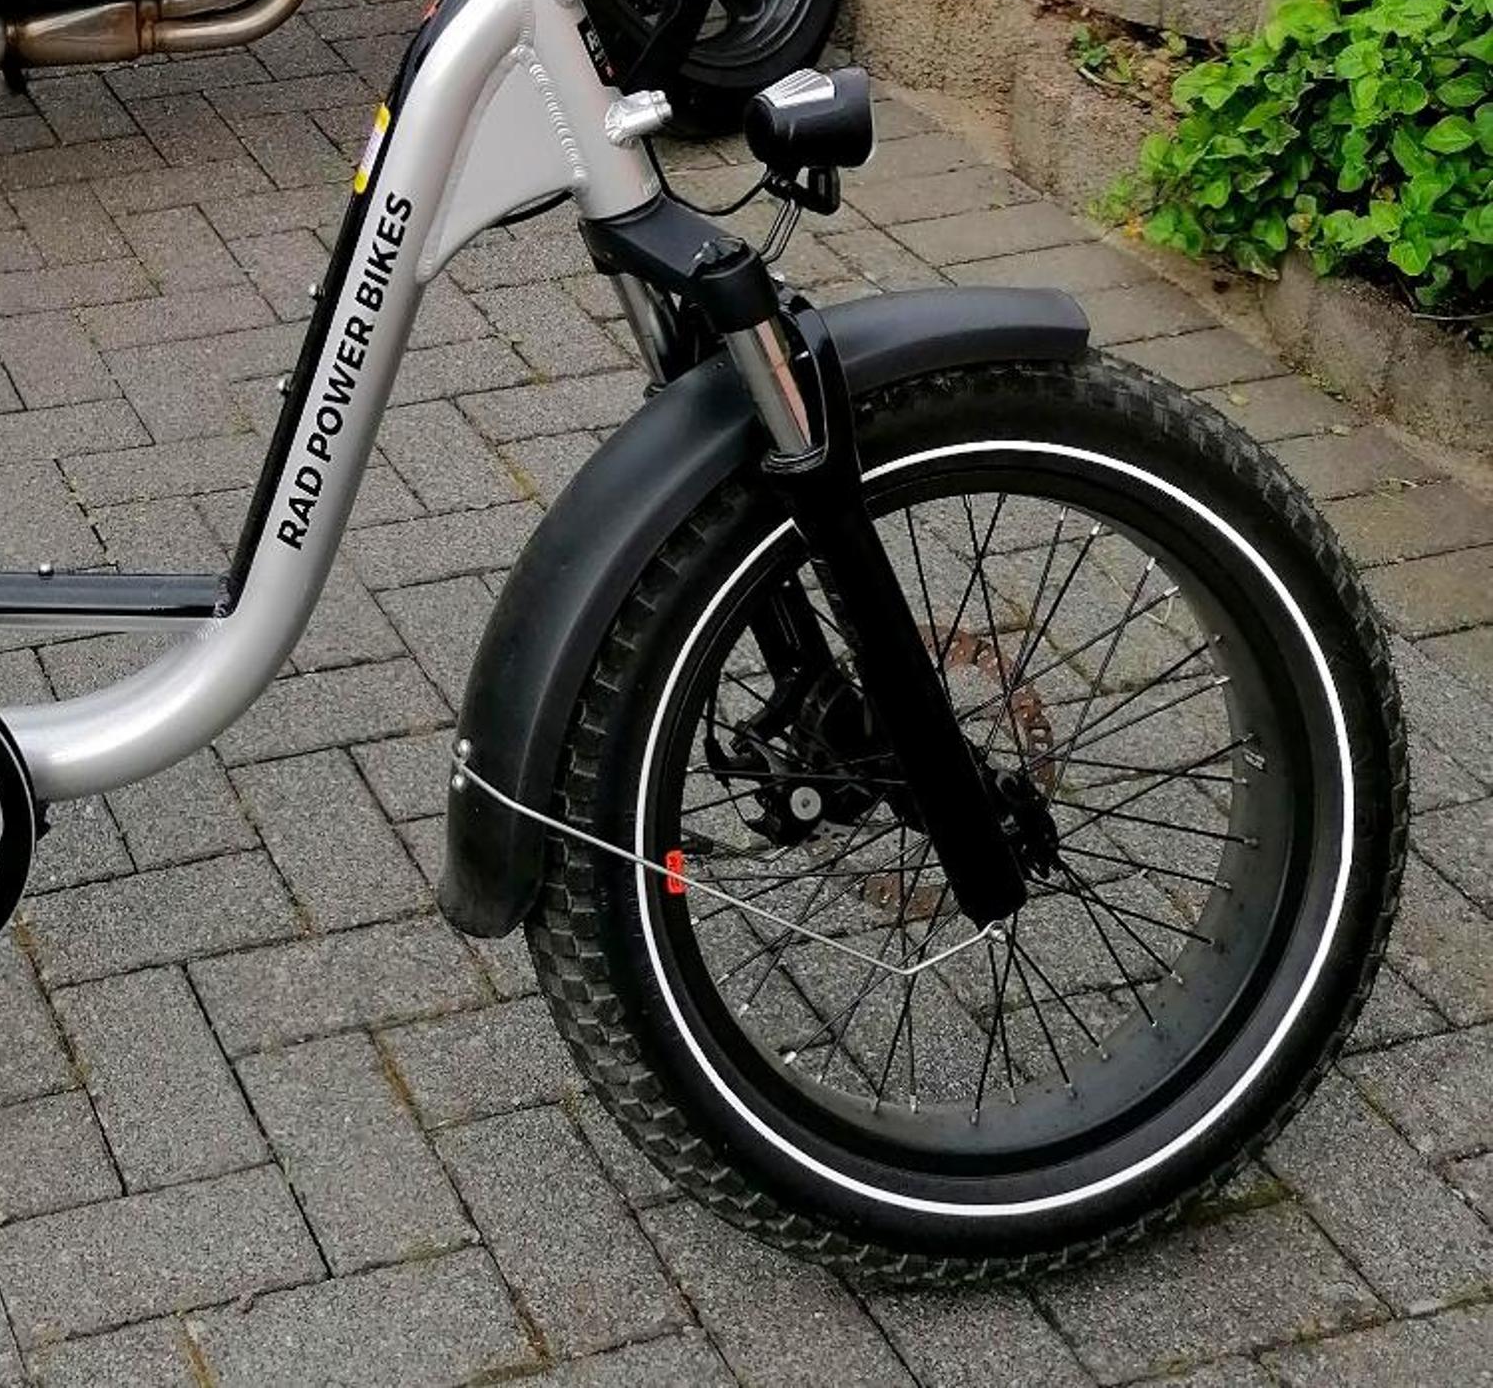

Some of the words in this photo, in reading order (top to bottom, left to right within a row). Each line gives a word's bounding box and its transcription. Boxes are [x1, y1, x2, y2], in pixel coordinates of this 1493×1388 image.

[277, 466, 323, 550] RAD
[307, 315, 374, 462] POWER
[355, 192, 413, 312] BIKES
